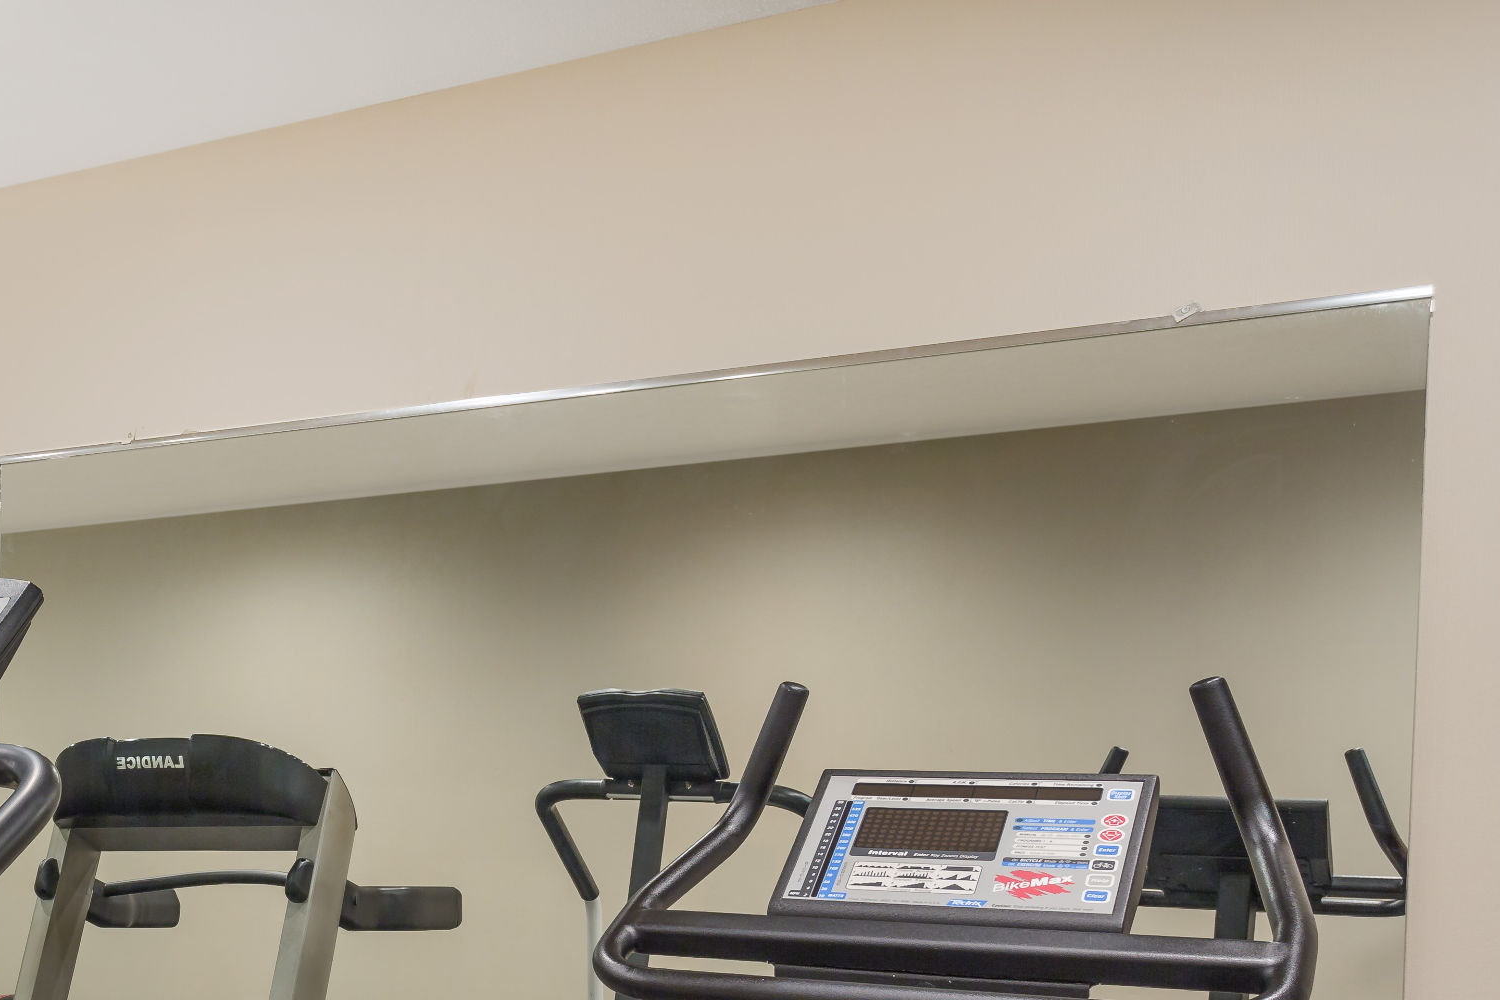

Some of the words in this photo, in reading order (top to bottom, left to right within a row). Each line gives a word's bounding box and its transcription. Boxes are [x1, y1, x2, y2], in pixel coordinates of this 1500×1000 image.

[867, 849, 909, 857] Interval
[992, 875, 1073, 892] BikeMax
[951, 899, 982, 907] Tectrix
